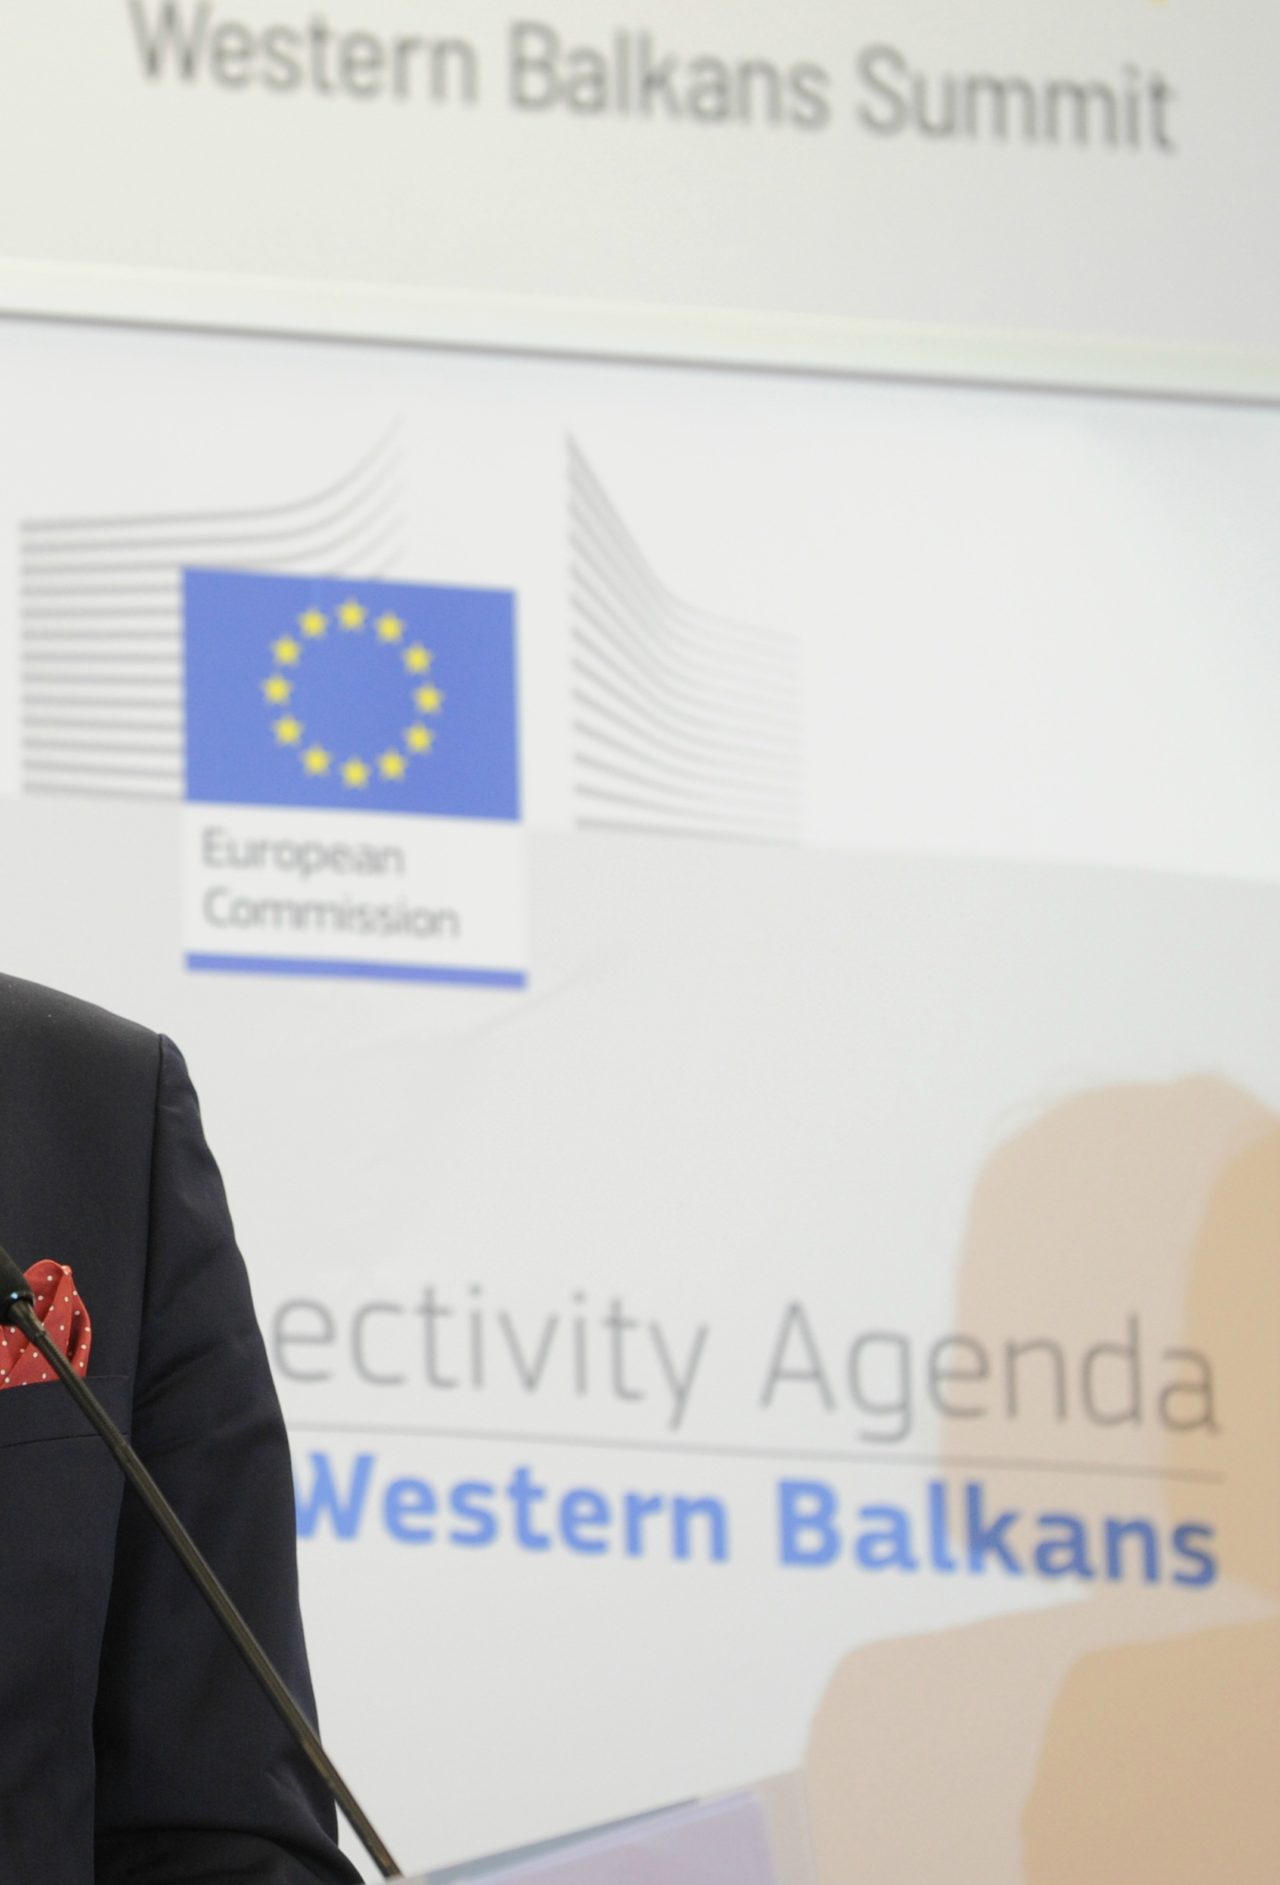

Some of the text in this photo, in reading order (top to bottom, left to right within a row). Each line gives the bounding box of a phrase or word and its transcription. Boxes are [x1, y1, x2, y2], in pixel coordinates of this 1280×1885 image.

[126, 0, 1178, 155] Western Balkans Summit
[201, 826, 405, 879] European
[203, 886, 461, 939] Commission
[270, 1282, 1223, 1443] ectivity Agenda
[296, 1451, 1220, 1588] Western Balkans
